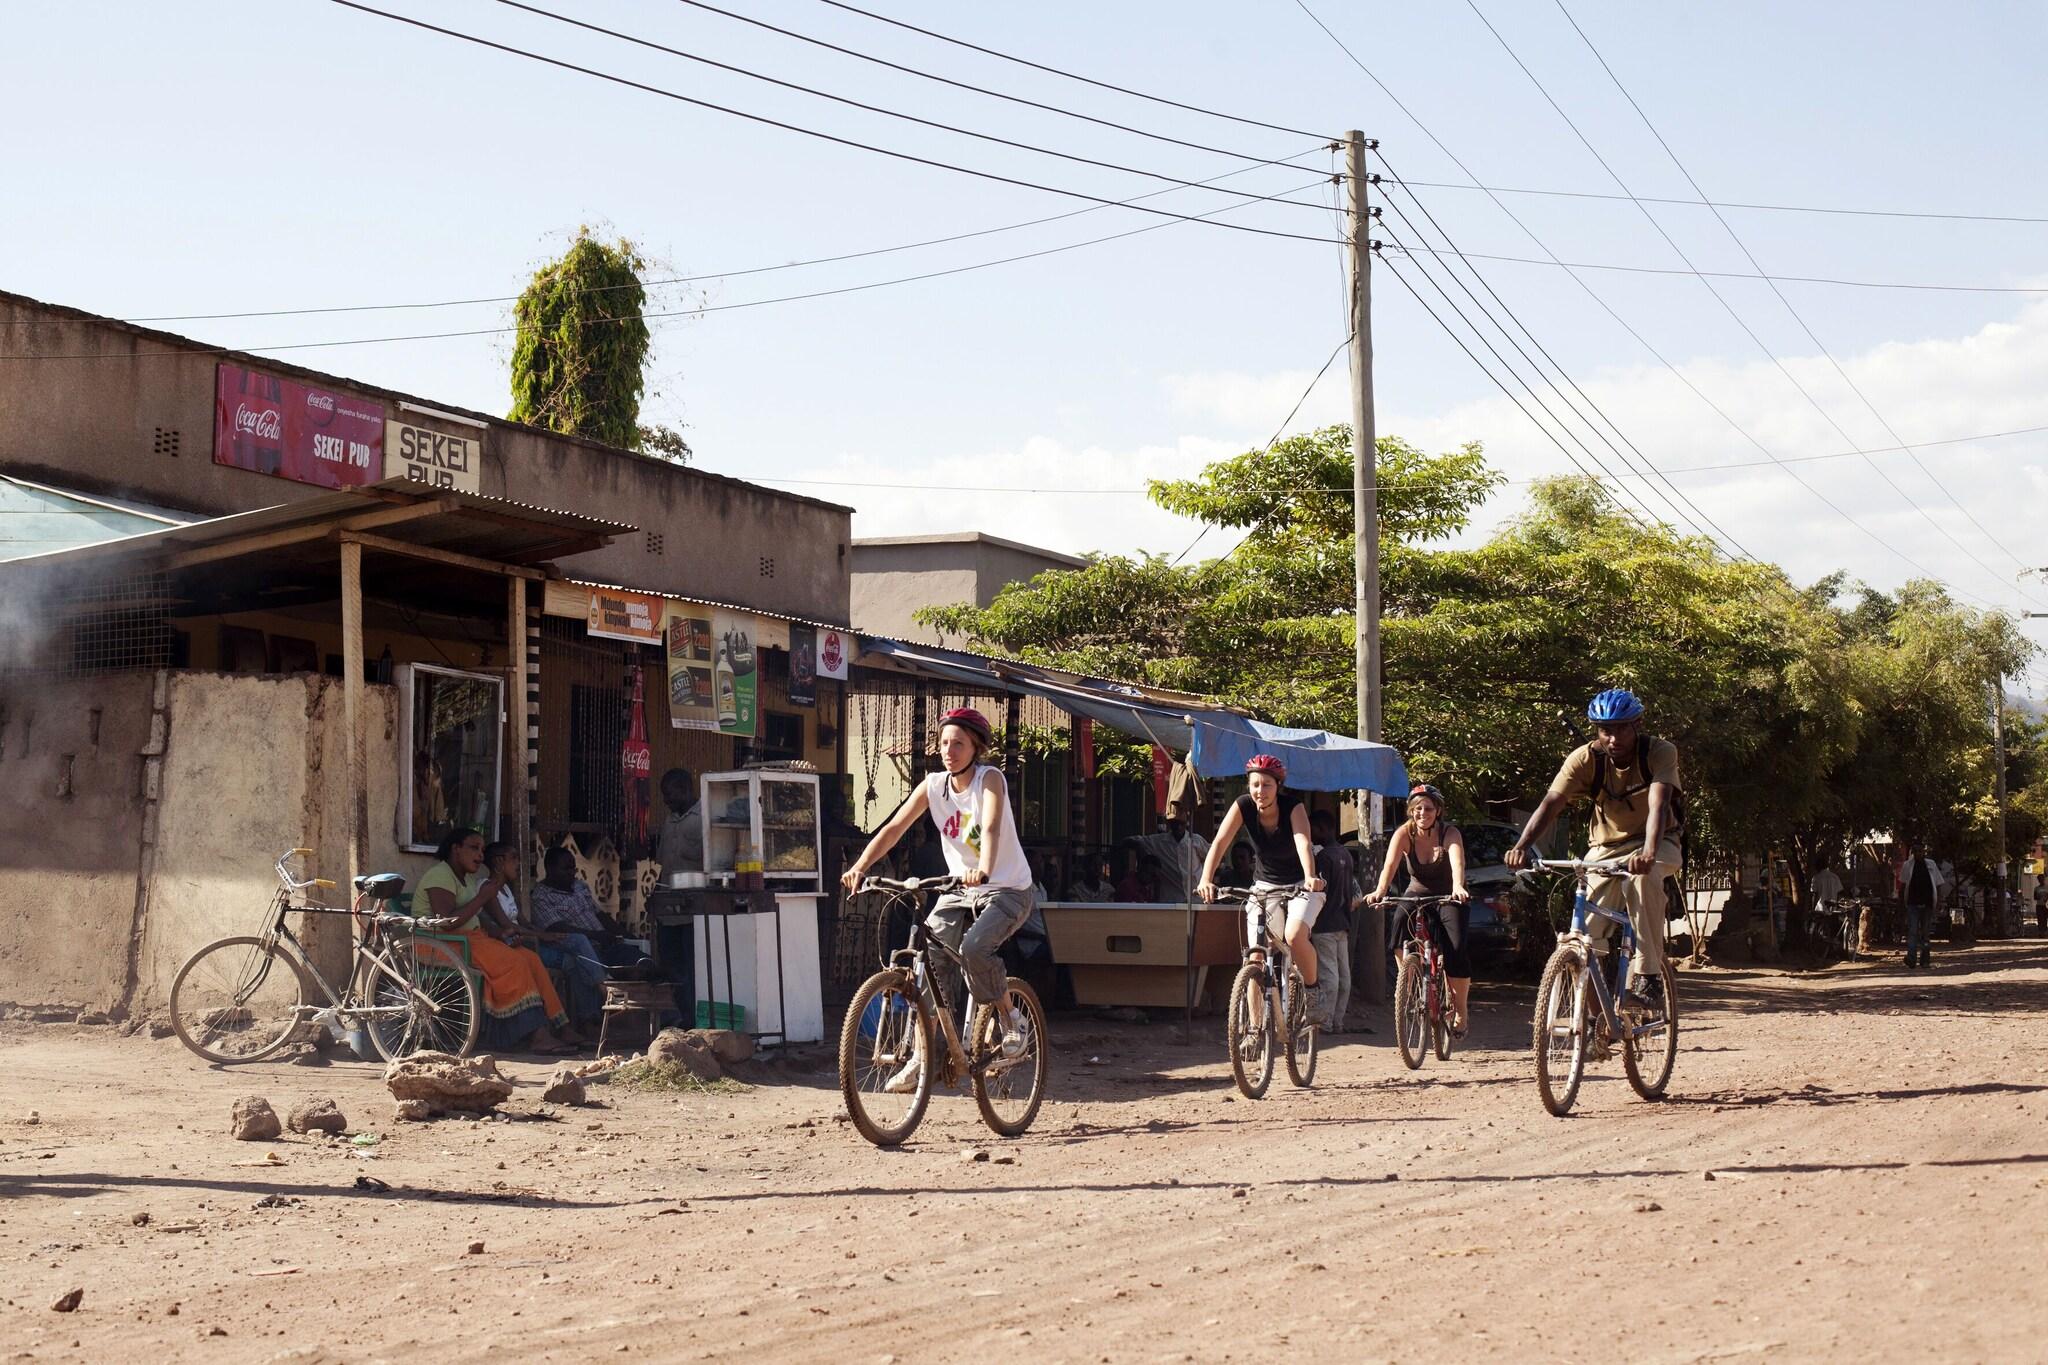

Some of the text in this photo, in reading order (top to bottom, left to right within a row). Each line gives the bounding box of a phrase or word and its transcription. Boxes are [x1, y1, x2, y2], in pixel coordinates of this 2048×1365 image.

[307, 392, 333, 411] Coca-Cola
[234, 402, 280, 440] Coca-Cola
[314, 433, 370, 468] SEKEI PUB
[400, 427, 468, 472] SEKEI
[623, 748, 650, 770] Coca-Cola
